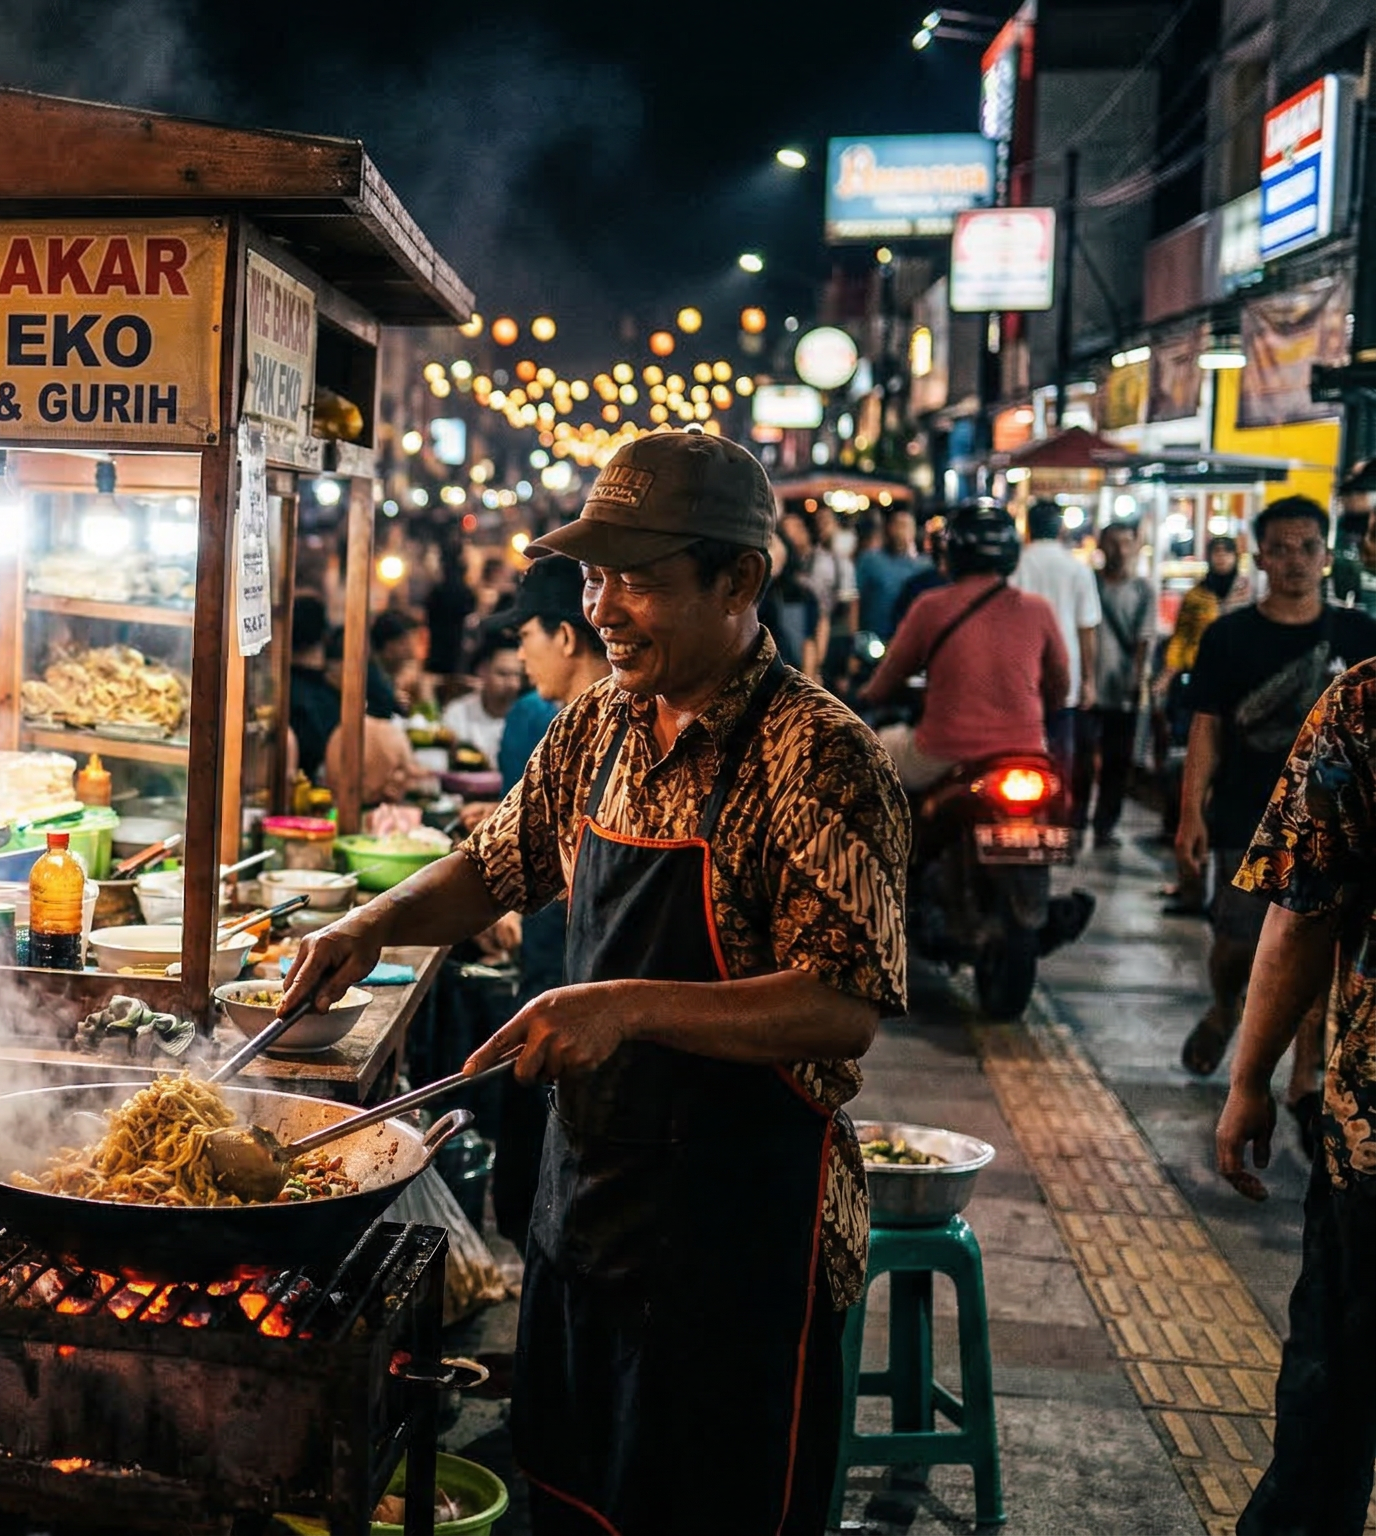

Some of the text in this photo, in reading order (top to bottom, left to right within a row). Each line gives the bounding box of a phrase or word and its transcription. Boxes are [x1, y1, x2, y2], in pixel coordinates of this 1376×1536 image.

[6, 315, 153, 368] EKO
[250, 268, 310, 356] MIE BAKAR
[38, 384, 177, 424] GURIH
[254, 352, 302, 422] PAK EKO
